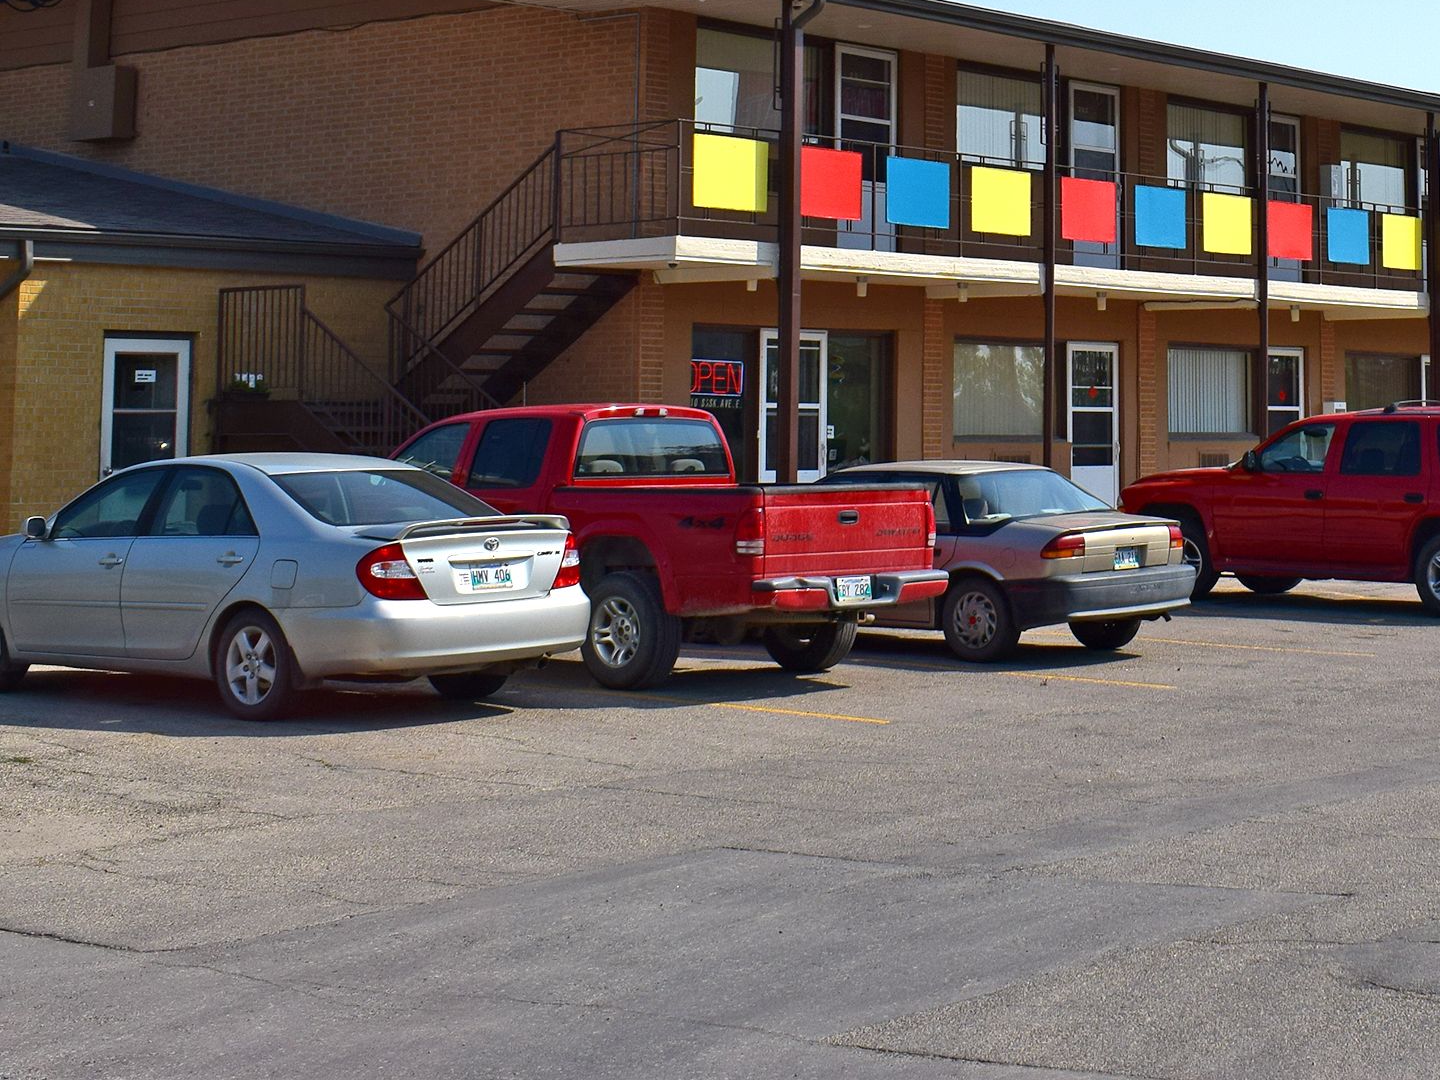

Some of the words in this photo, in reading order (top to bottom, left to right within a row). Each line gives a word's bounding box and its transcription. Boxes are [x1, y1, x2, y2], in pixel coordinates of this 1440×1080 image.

[472, 569, 489, 583] HMV
[494, 568, 511, 582] 406
[854, 583, 871, 596] 282
